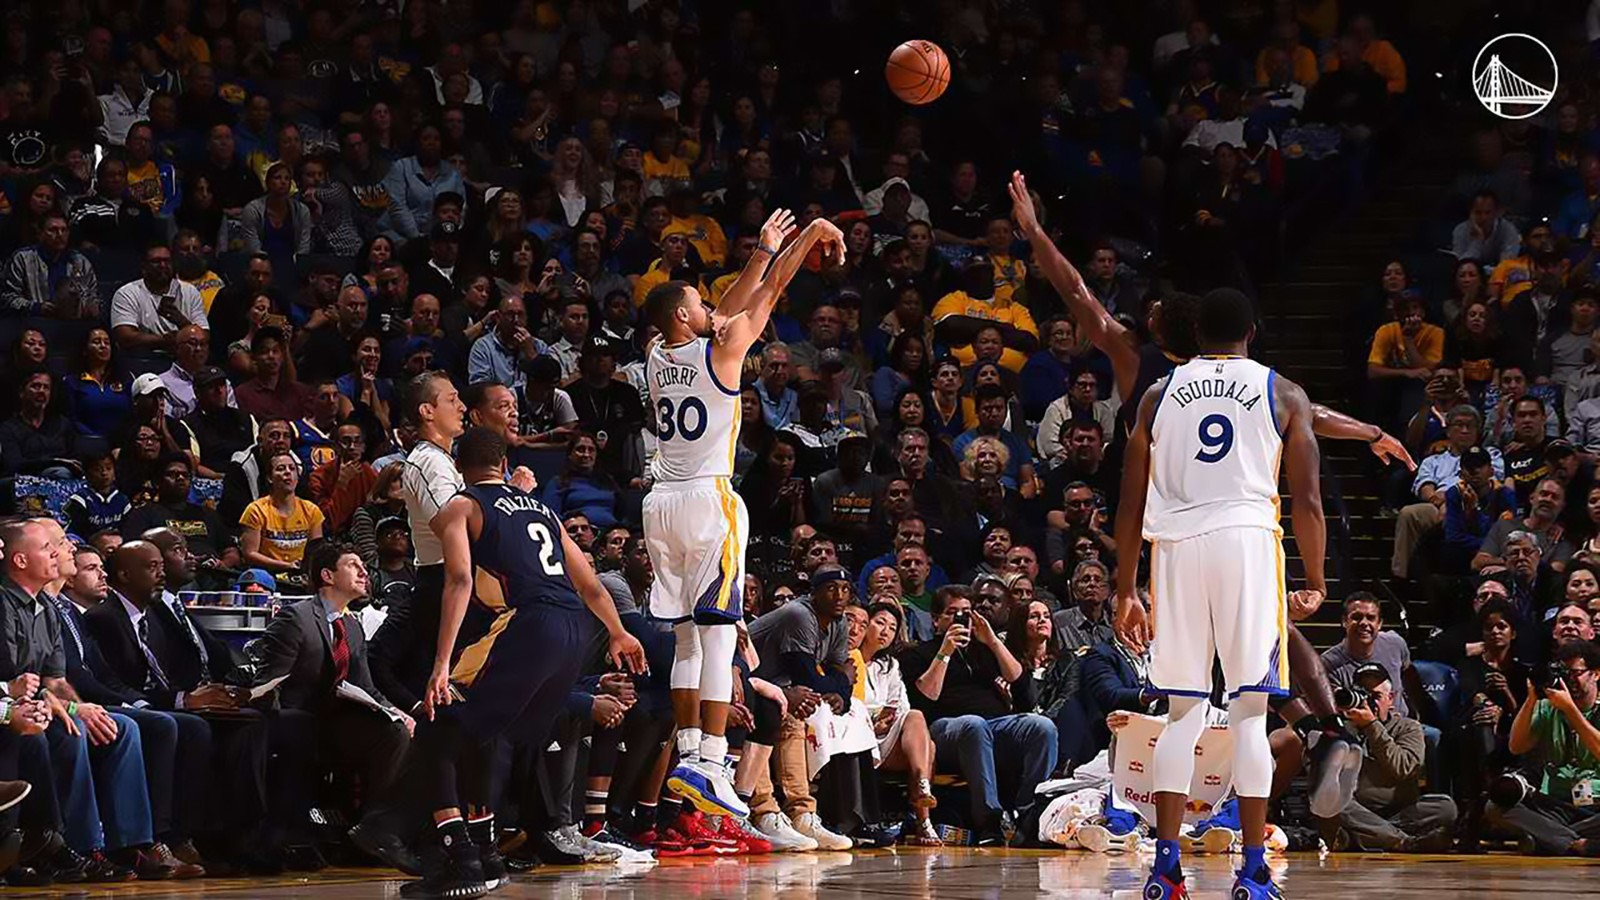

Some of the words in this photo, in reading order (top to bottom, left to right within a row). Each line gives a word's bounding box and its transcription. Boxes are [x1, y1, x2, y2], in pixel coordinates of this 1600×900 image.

[656, 367, 697, 388] CURRY
[1170, 379, 1261, 411] IGUODALA
[657, 396, 708, 441] 30
[1194, 414, 1234, 463] 9
[493, 496, 551, 519] FRAZIER
[527, 522, 564, 576] 2
